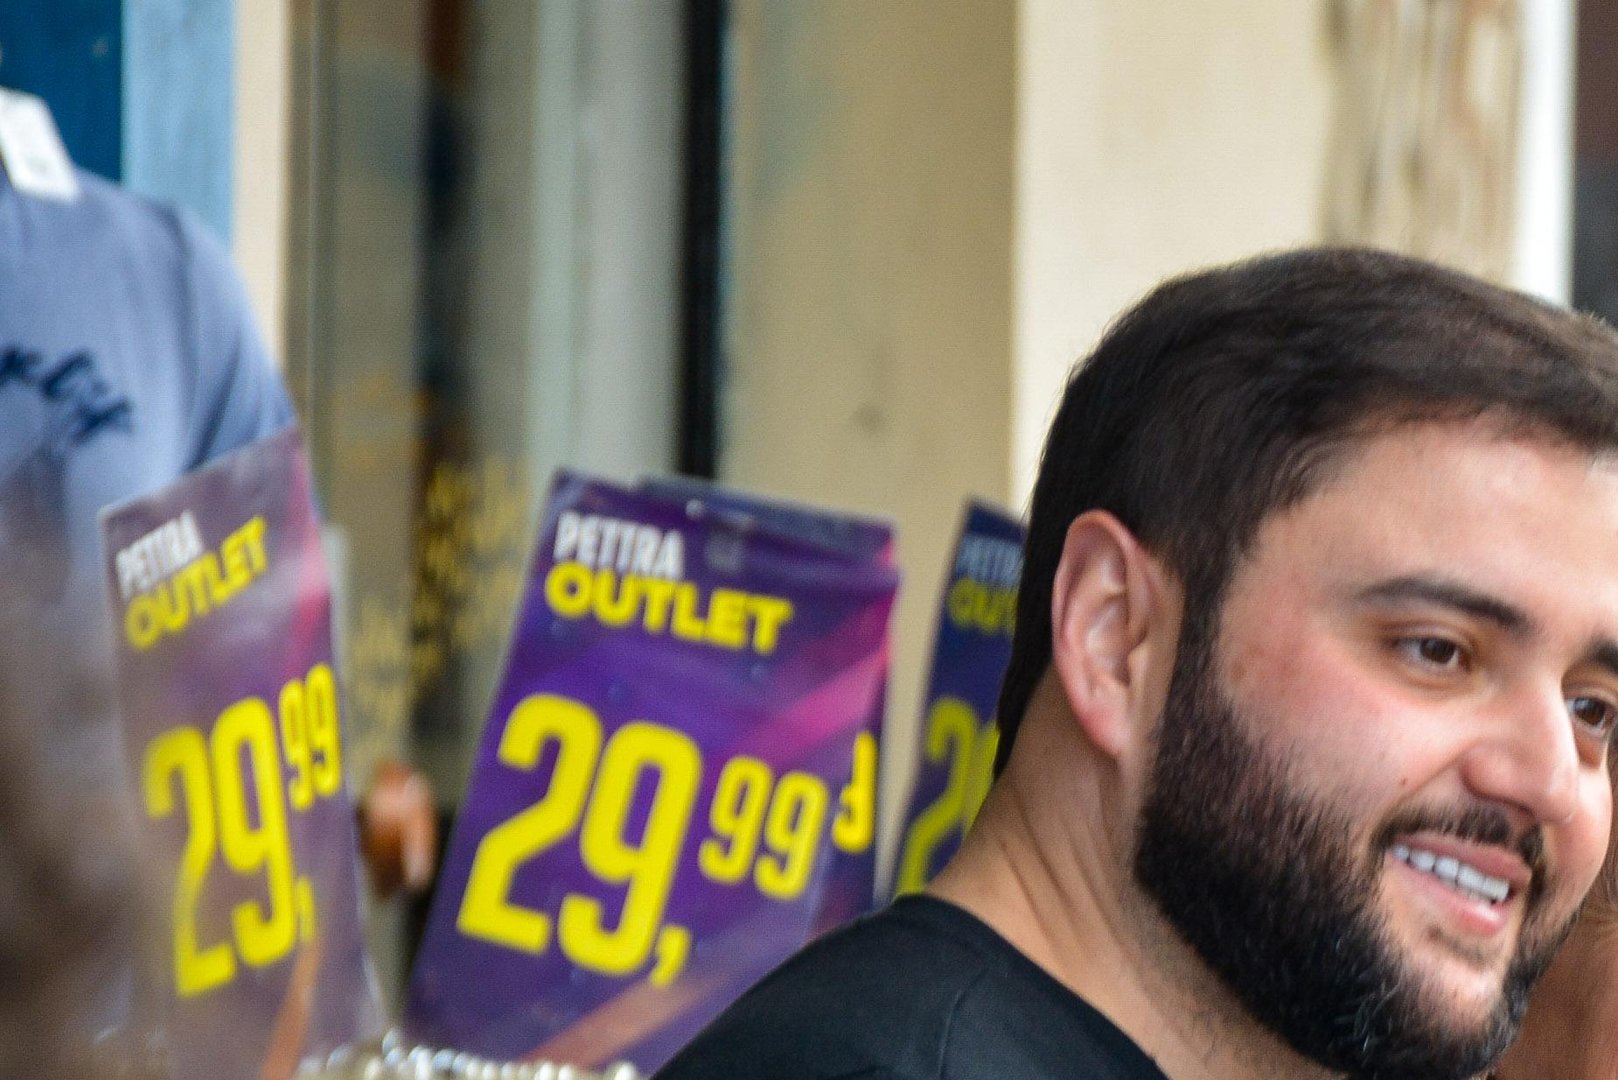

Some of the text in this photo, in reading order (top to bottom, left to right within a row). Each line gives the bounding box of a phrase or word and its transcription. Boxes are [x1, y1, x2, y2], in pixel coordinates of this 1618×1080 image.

[114, 509, 201, 598] PETTRA
[125, 516, 267, 650] OUTLET
[552, 511, 685, 581] PETTRA
[544, 561, 793, 654] OUTLET
